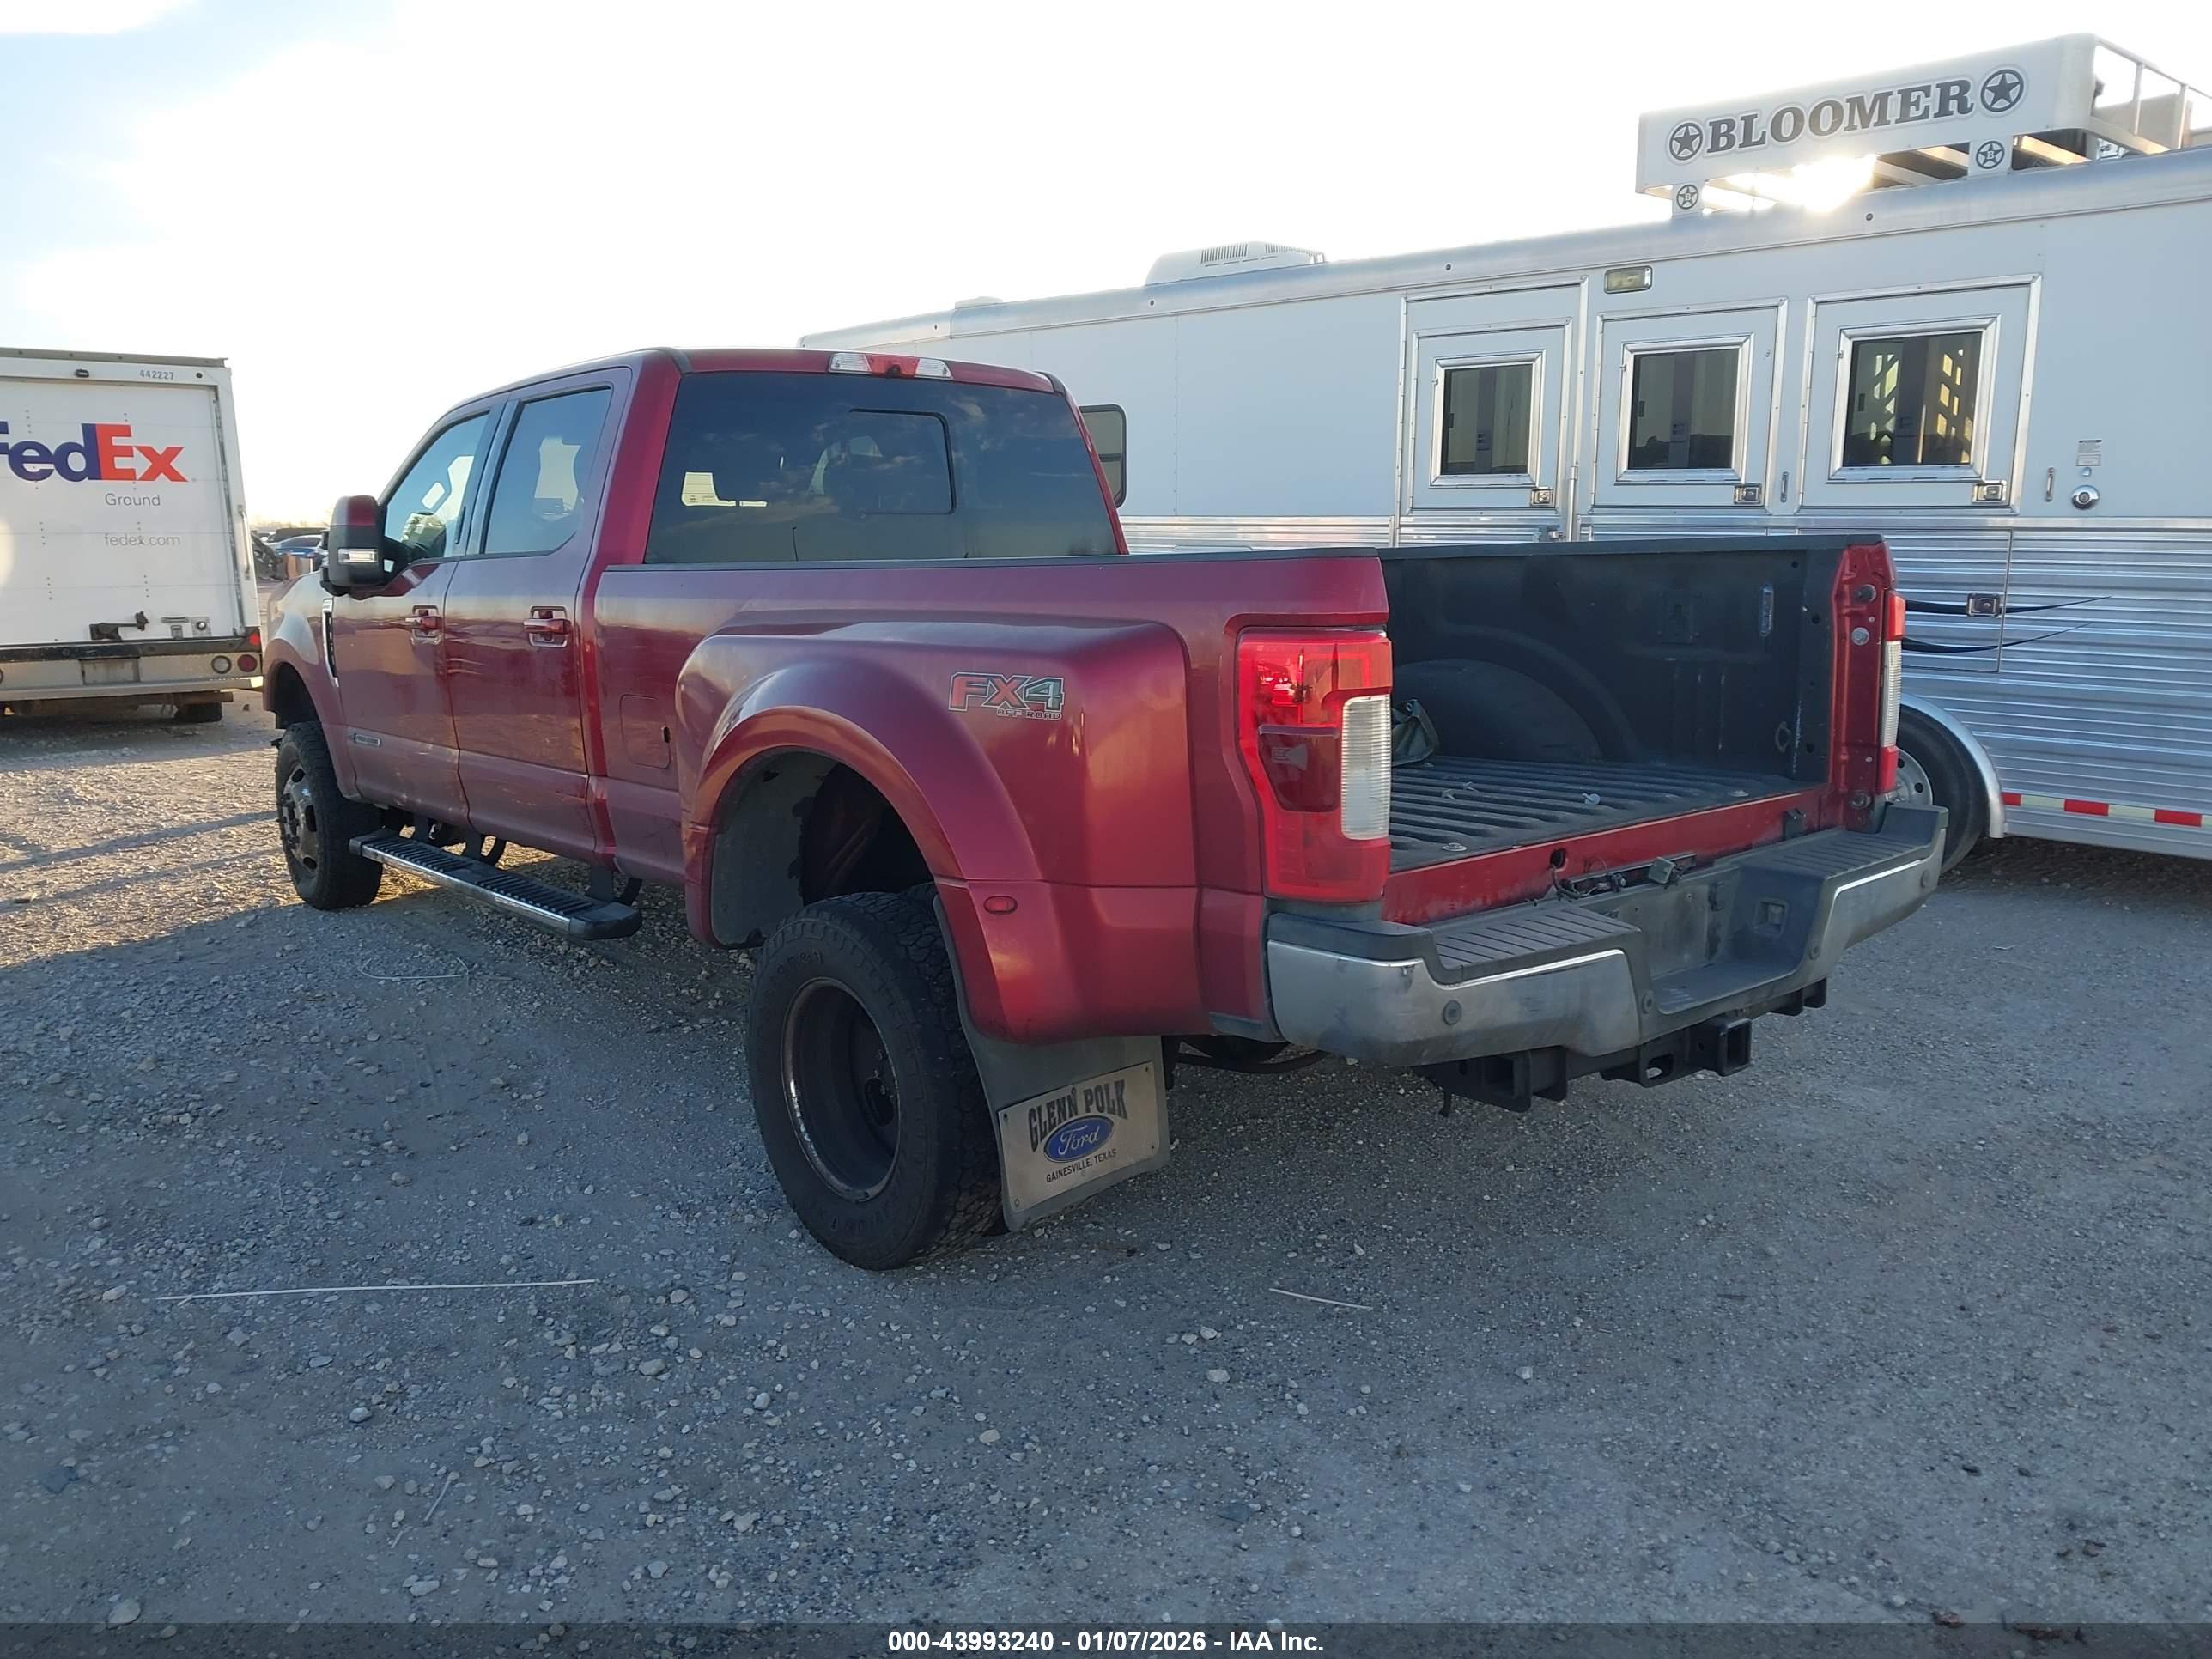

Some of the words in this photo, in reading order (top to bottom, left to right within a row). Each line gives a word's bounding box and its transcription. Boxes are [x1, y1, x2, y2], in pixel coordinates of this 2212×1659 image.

[1706, 78, 1974, 154] BLOOMER
[139, 369, 175, 380] 442227
[0, 421, 189, 483] edEx
[105, 492, 161, 507] Ground
[105, 532, 180, 547] fedex.com
[948, 672, 1065, 712] FX4
[997, 708, 1022, 718] OFF
[1026, 709, 1063, 720] ROAD
[1028, 1093, 1079, 1152] GLENN
[1084, 1079, 1128, 1120] POLK
[1058, 1124, 1101, 1155] Ford
[1046, 1158, 1093, 1183] GAINESVILLE,
[1094, 1148, 1118, 1164] TEXAS
